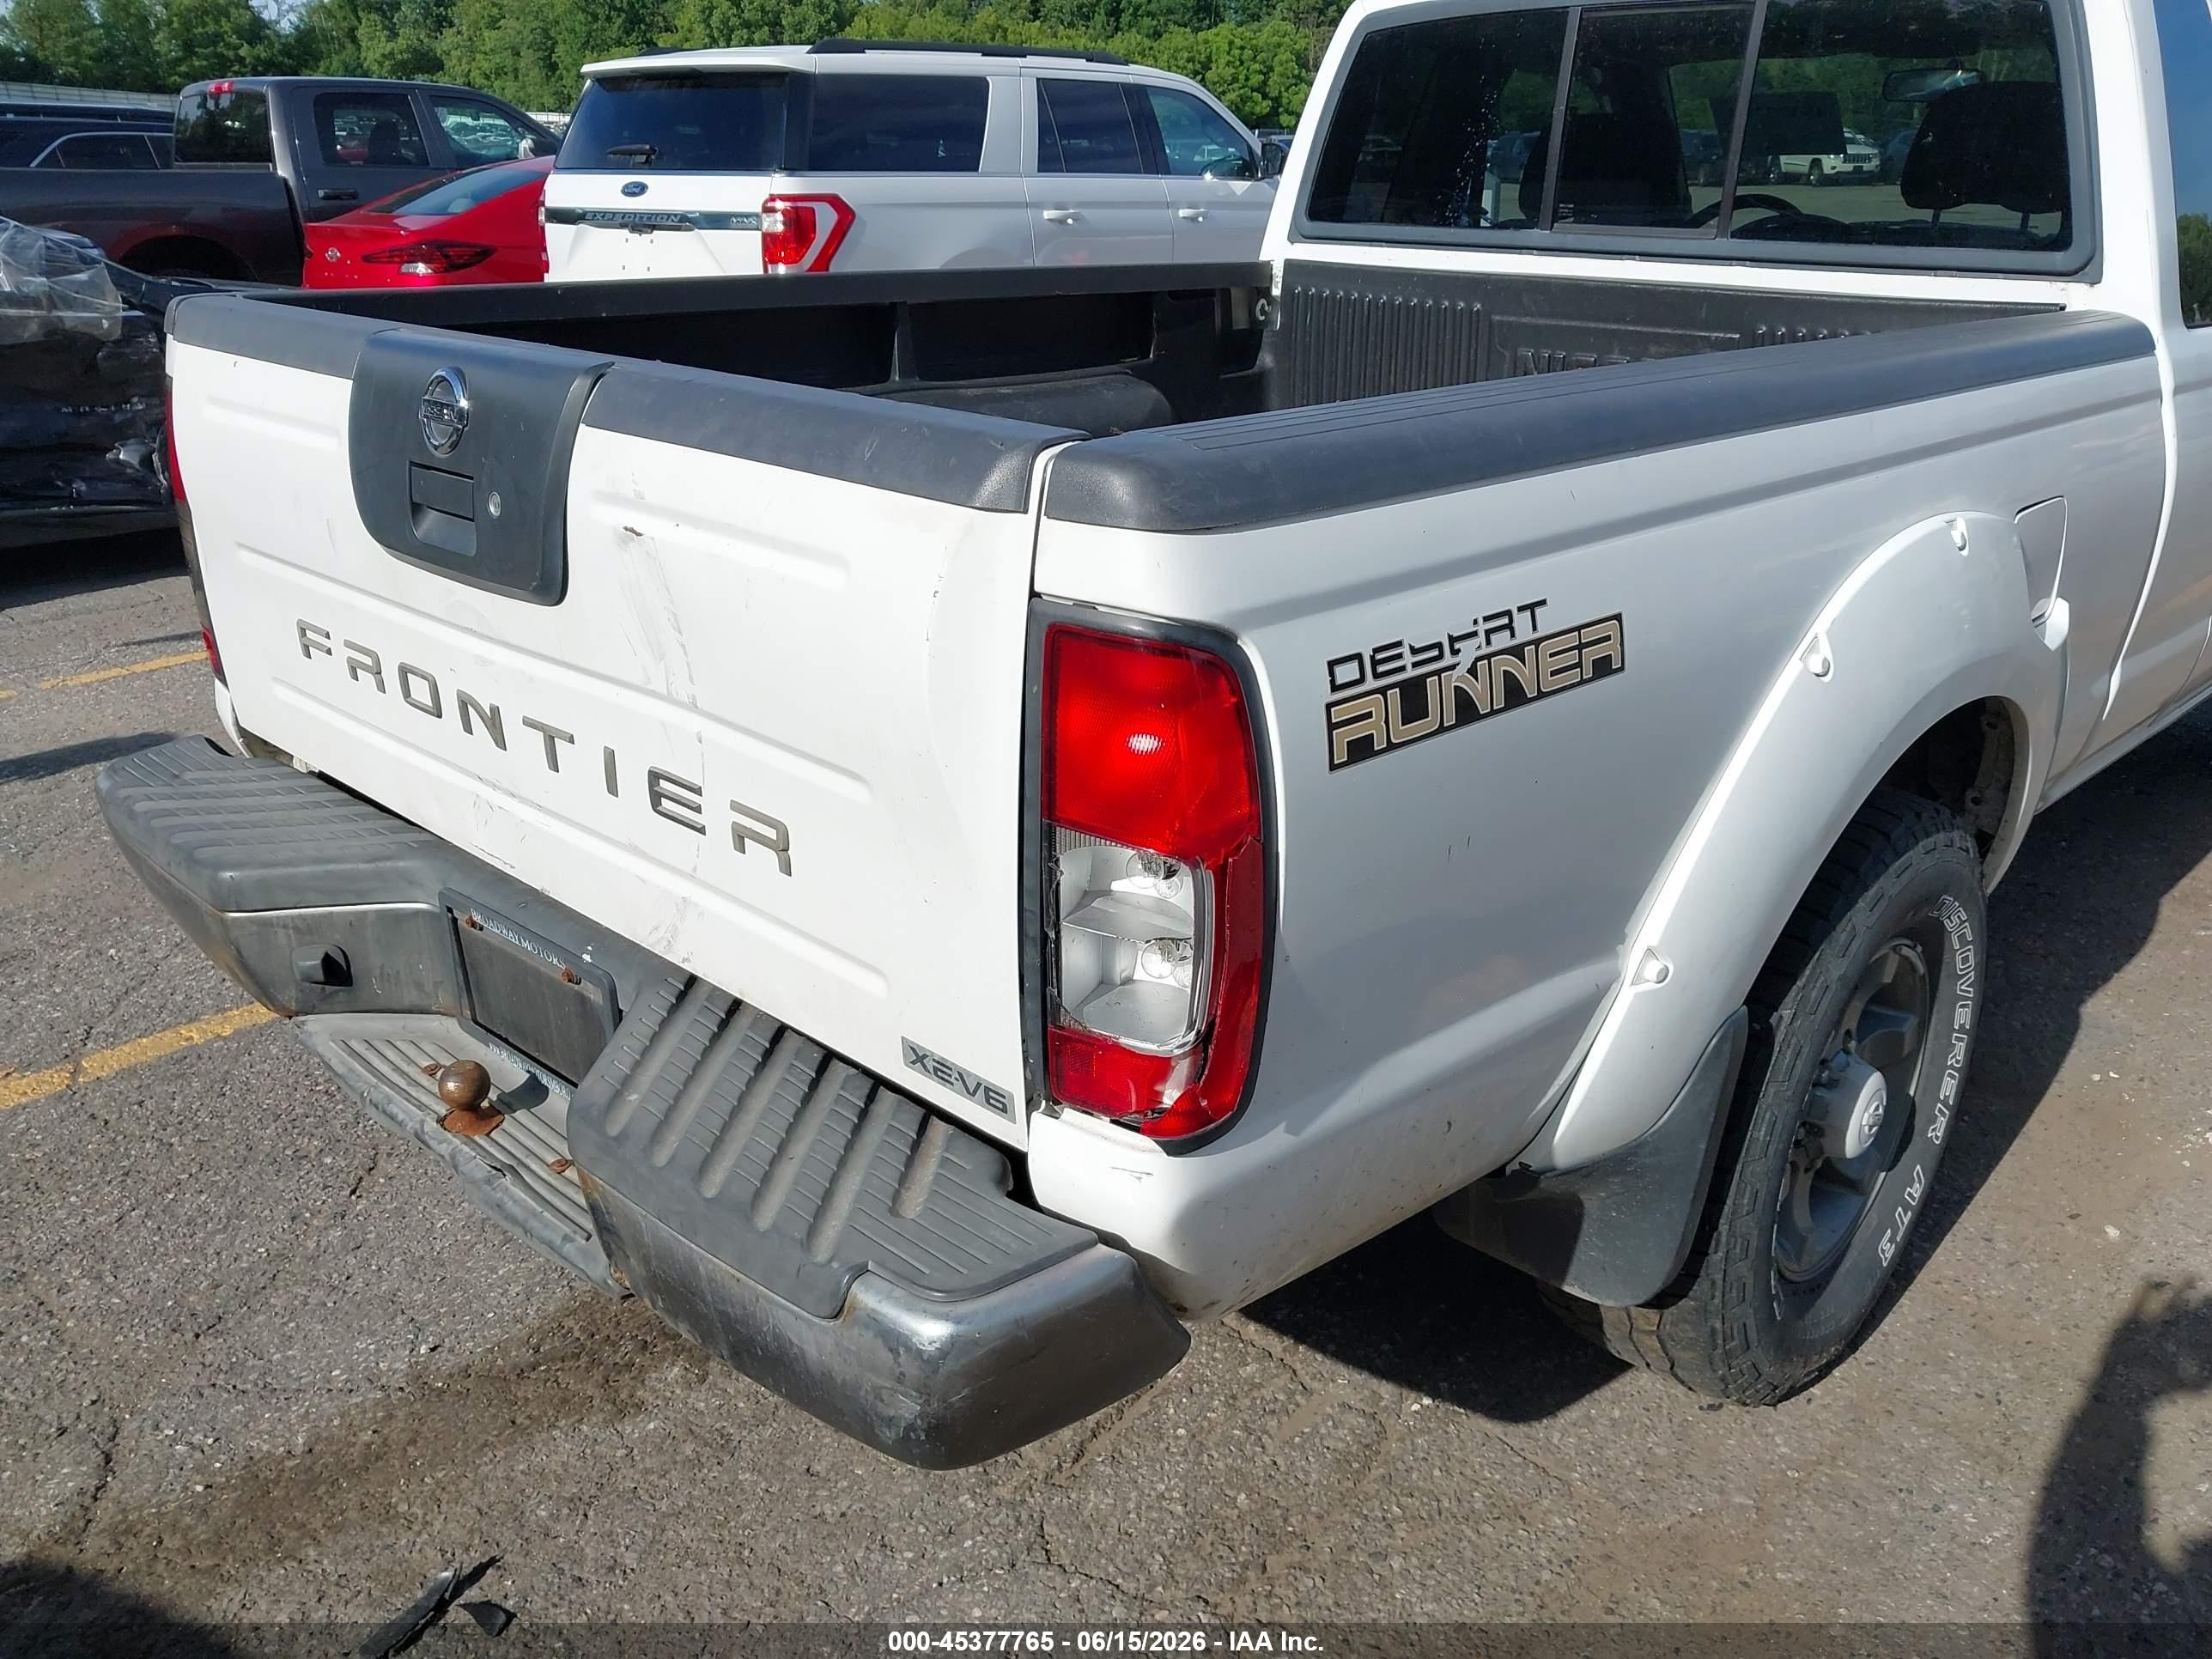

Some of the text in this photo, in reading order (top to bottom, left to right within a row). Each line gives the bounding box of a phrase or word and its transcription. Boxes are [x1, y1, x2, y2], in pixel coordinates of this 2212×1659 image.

[585, 212, 681, 223] EXPEDITION
[295, 618, 792, 878] FRONTIER
[1330, 618, 1623, 764] RUNNER
[470, 907, 567, 970] BROADWAY MOTORS
[1878, 894, 1975, 1267] DISCOVERER AT3
